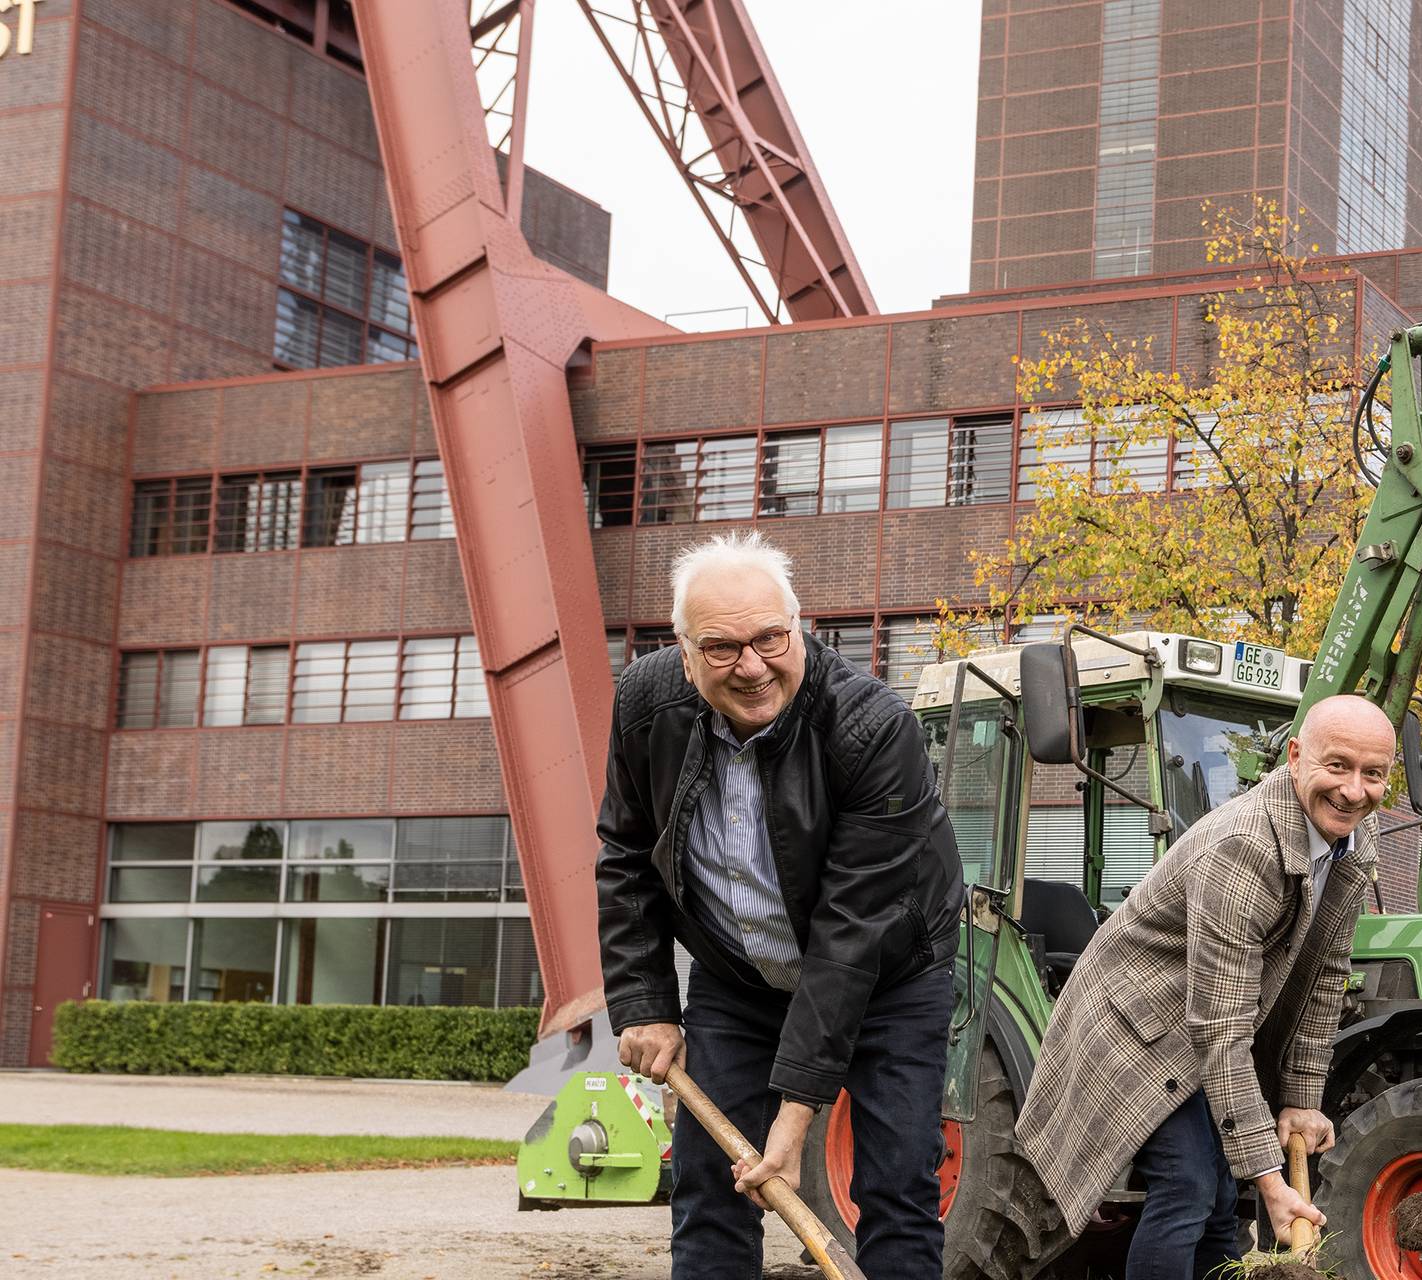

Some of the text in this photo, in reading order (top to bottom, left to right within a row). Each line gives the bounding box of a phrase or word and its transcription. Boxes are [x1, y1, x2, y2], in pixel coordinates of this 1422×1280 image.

[1245, 647, 1261, 665] GE
[1237, 664, 1279, 687] GG 932
